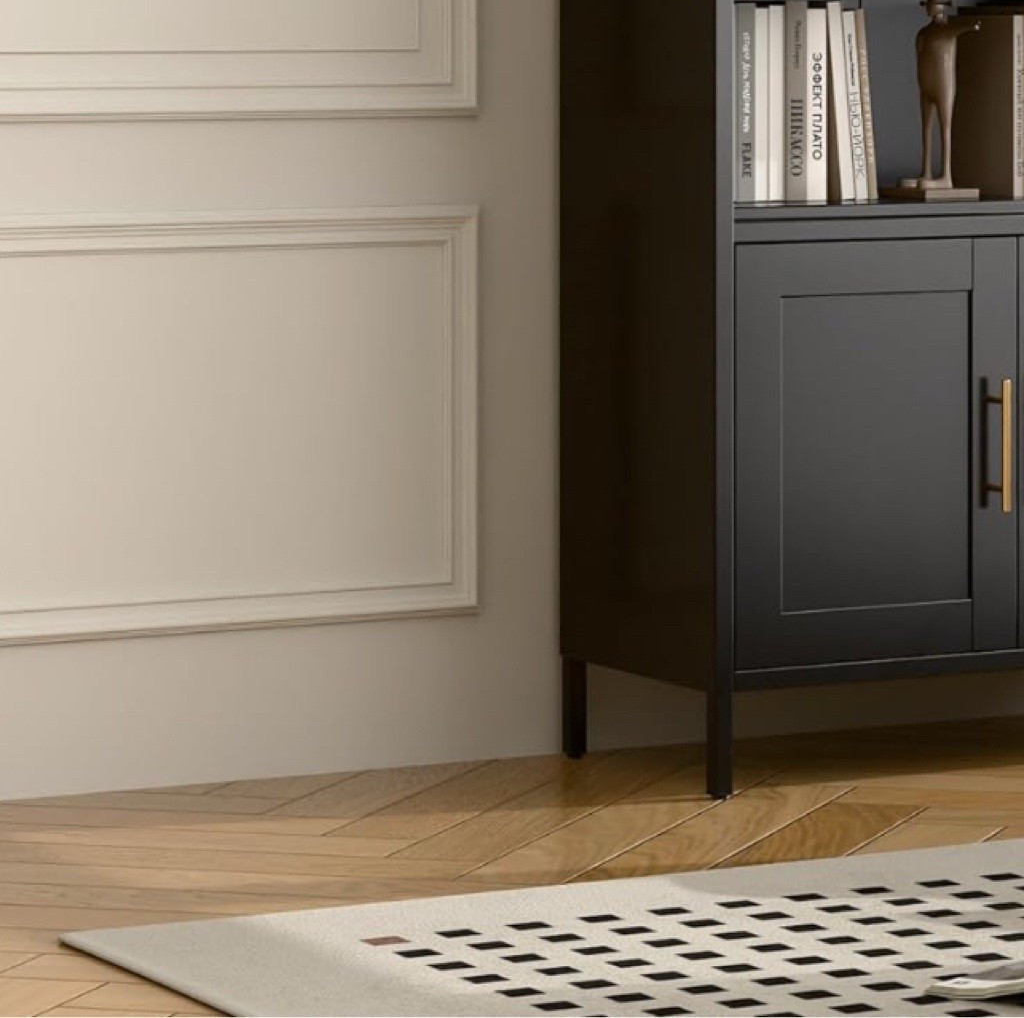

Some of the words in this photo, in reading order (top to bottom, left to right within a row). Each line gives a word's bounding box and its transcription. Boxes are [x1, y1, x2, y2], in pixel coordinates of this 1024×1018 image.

[812, 52, 823, 110] ЭФФЕКТ
[741, 142, 752, 178] FLAKE
[790, 98, 804, 177] ПИКАССО
[812, 114, 823, 161] ПЛАТО
